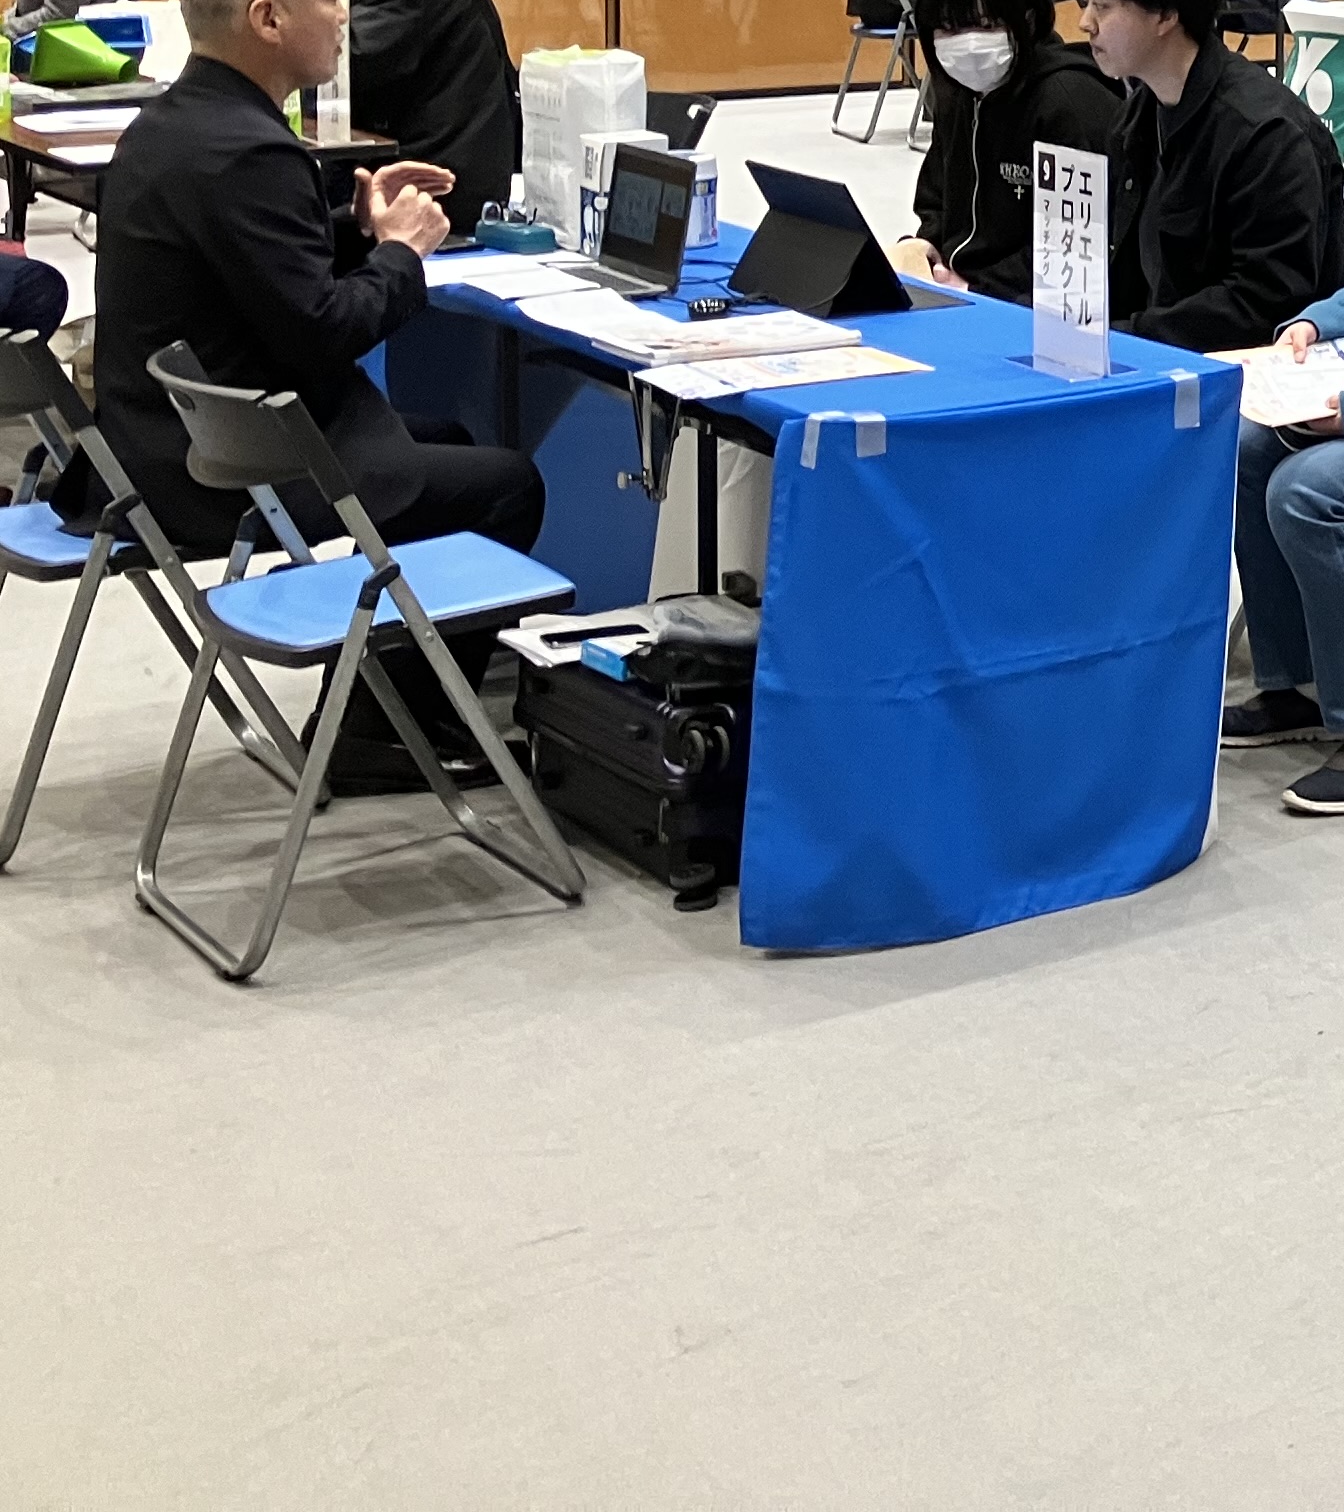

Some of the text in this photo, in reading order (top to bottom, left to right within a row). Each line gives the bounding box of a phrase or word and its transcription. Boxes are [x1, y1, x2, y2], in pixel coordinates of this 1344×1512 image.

[1043, 199, 1051, 277] マッチング
[1061, 164, 1076, 322] プロダクト
[1078, 171, 1093, 326] エリエール
